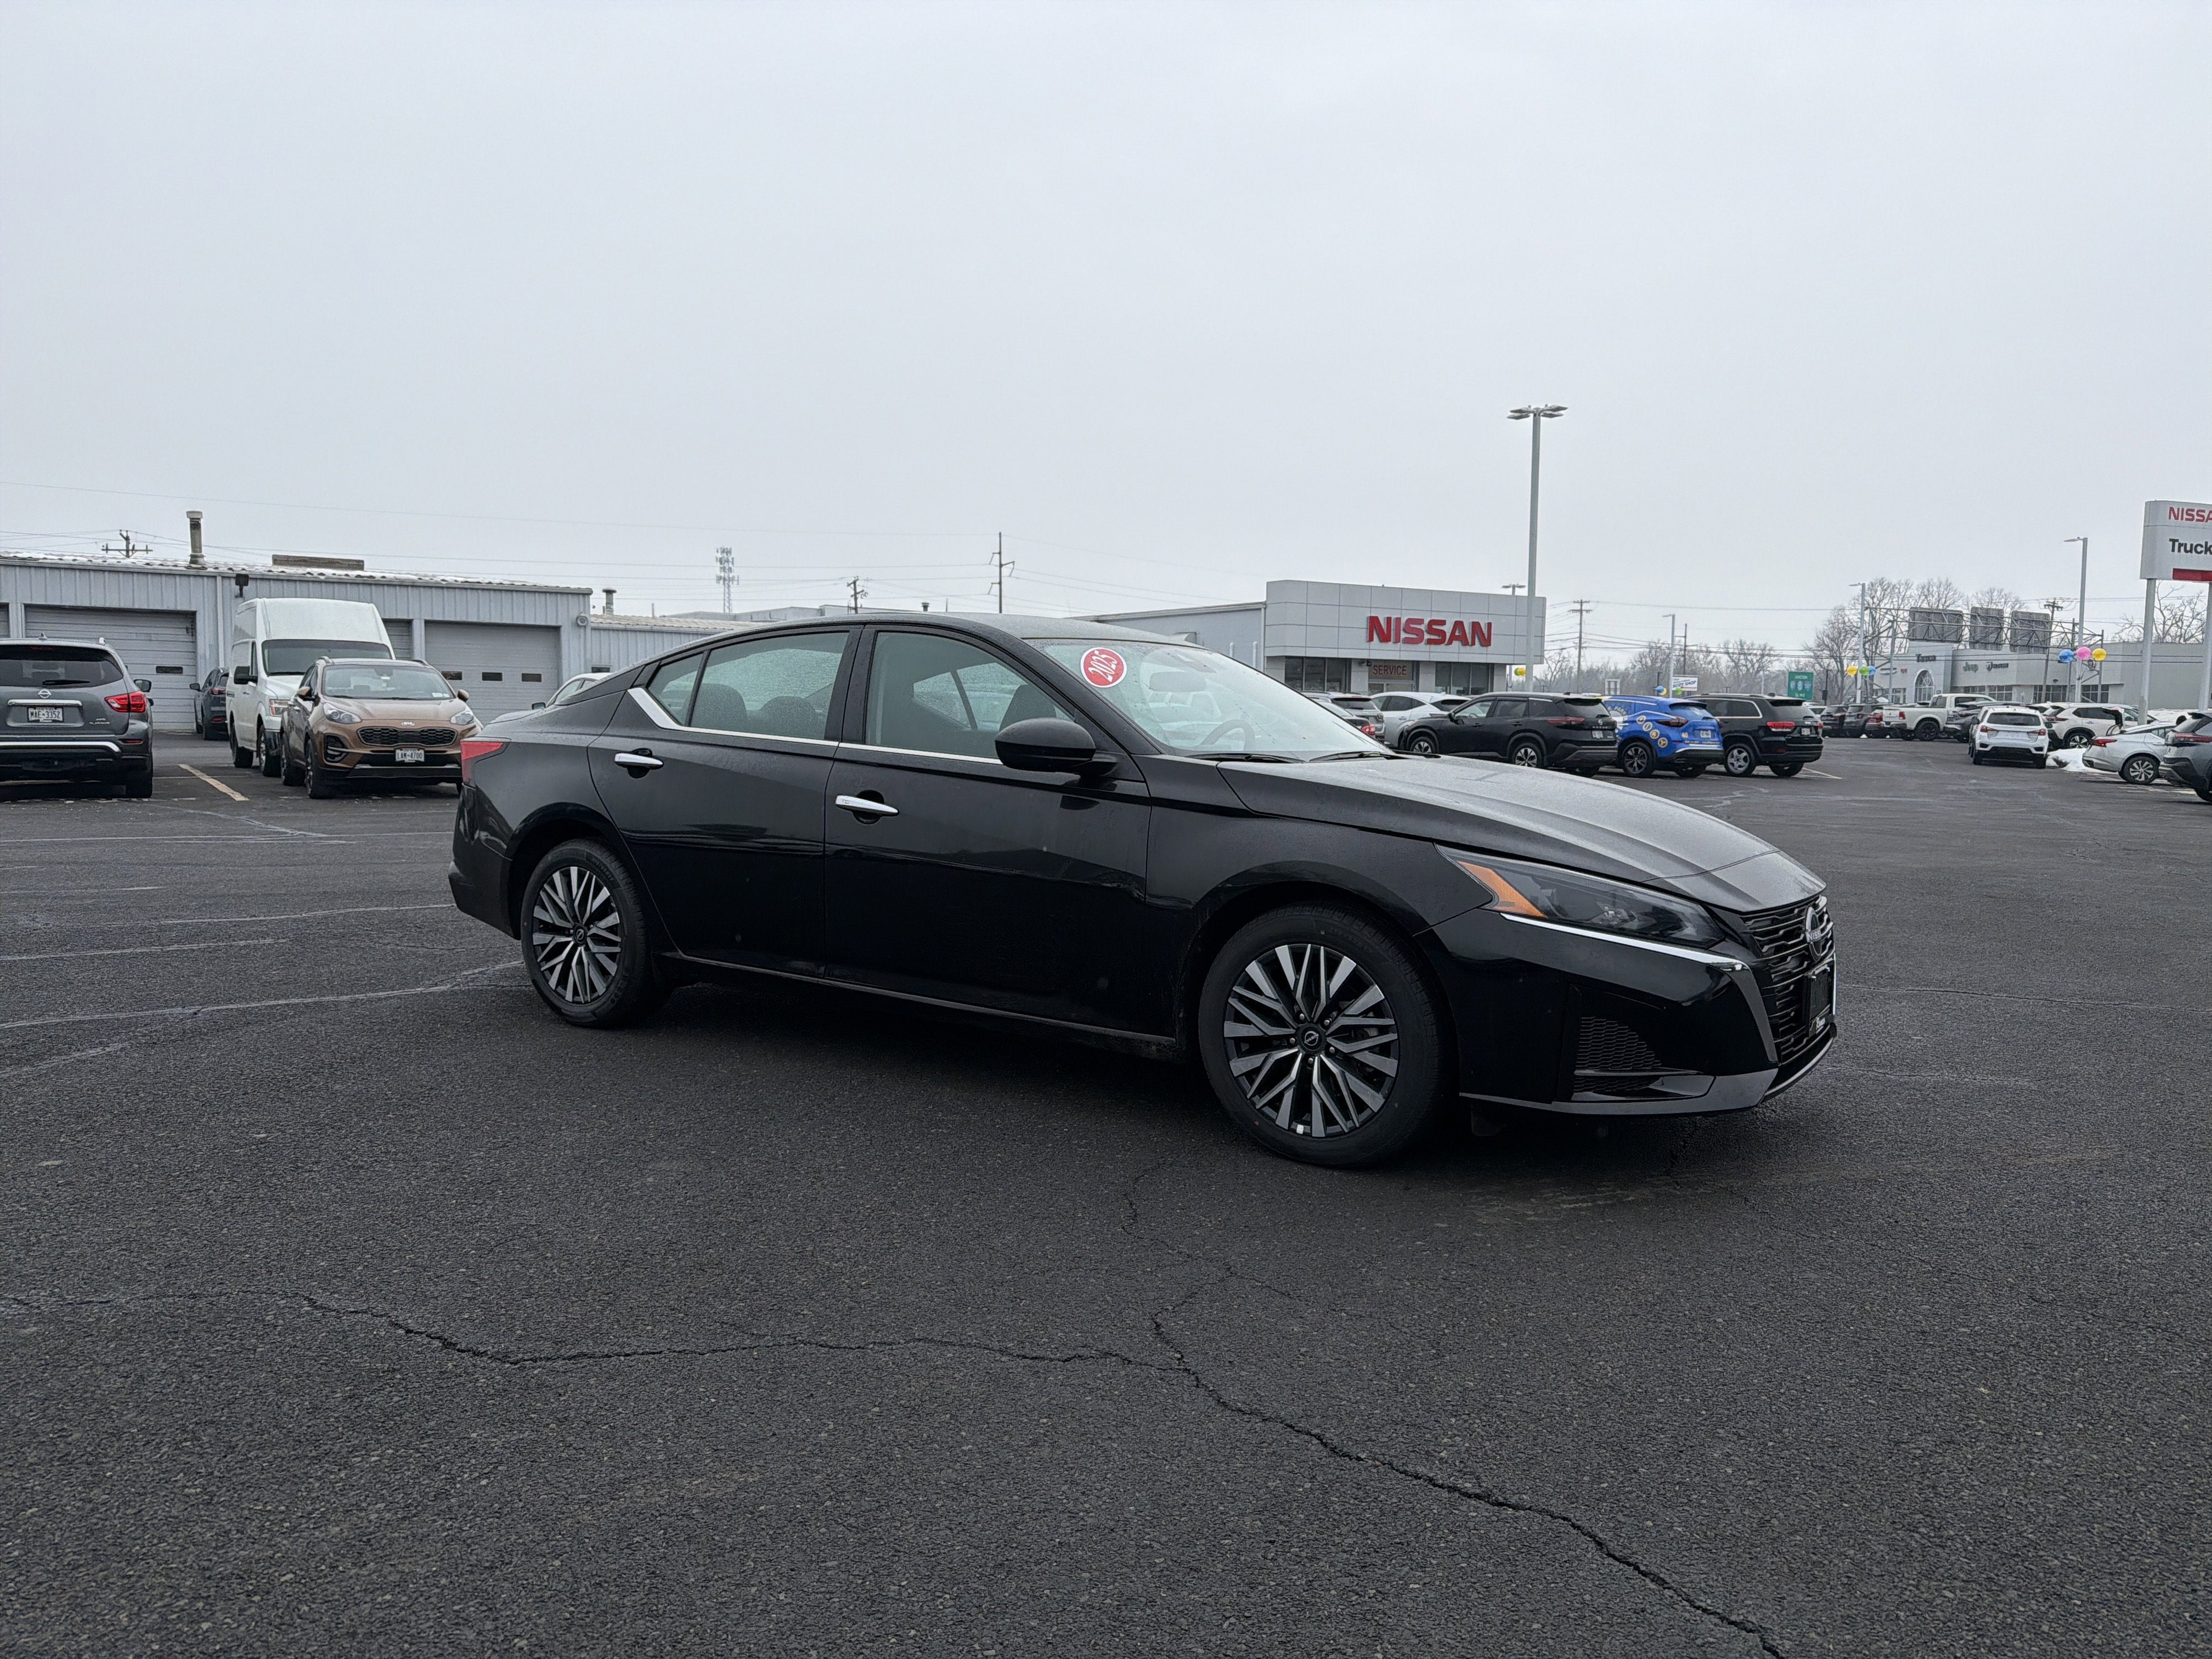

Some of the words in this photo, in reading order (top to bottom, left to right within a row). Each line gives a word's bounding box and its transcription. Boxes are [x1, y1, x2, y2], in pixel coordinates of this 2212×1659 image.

[1368, 615, 1492, 647] NISSAN
[1088, 650, 1118, 682] 2025
[1373, 665, 1407, 676] SERVICE
